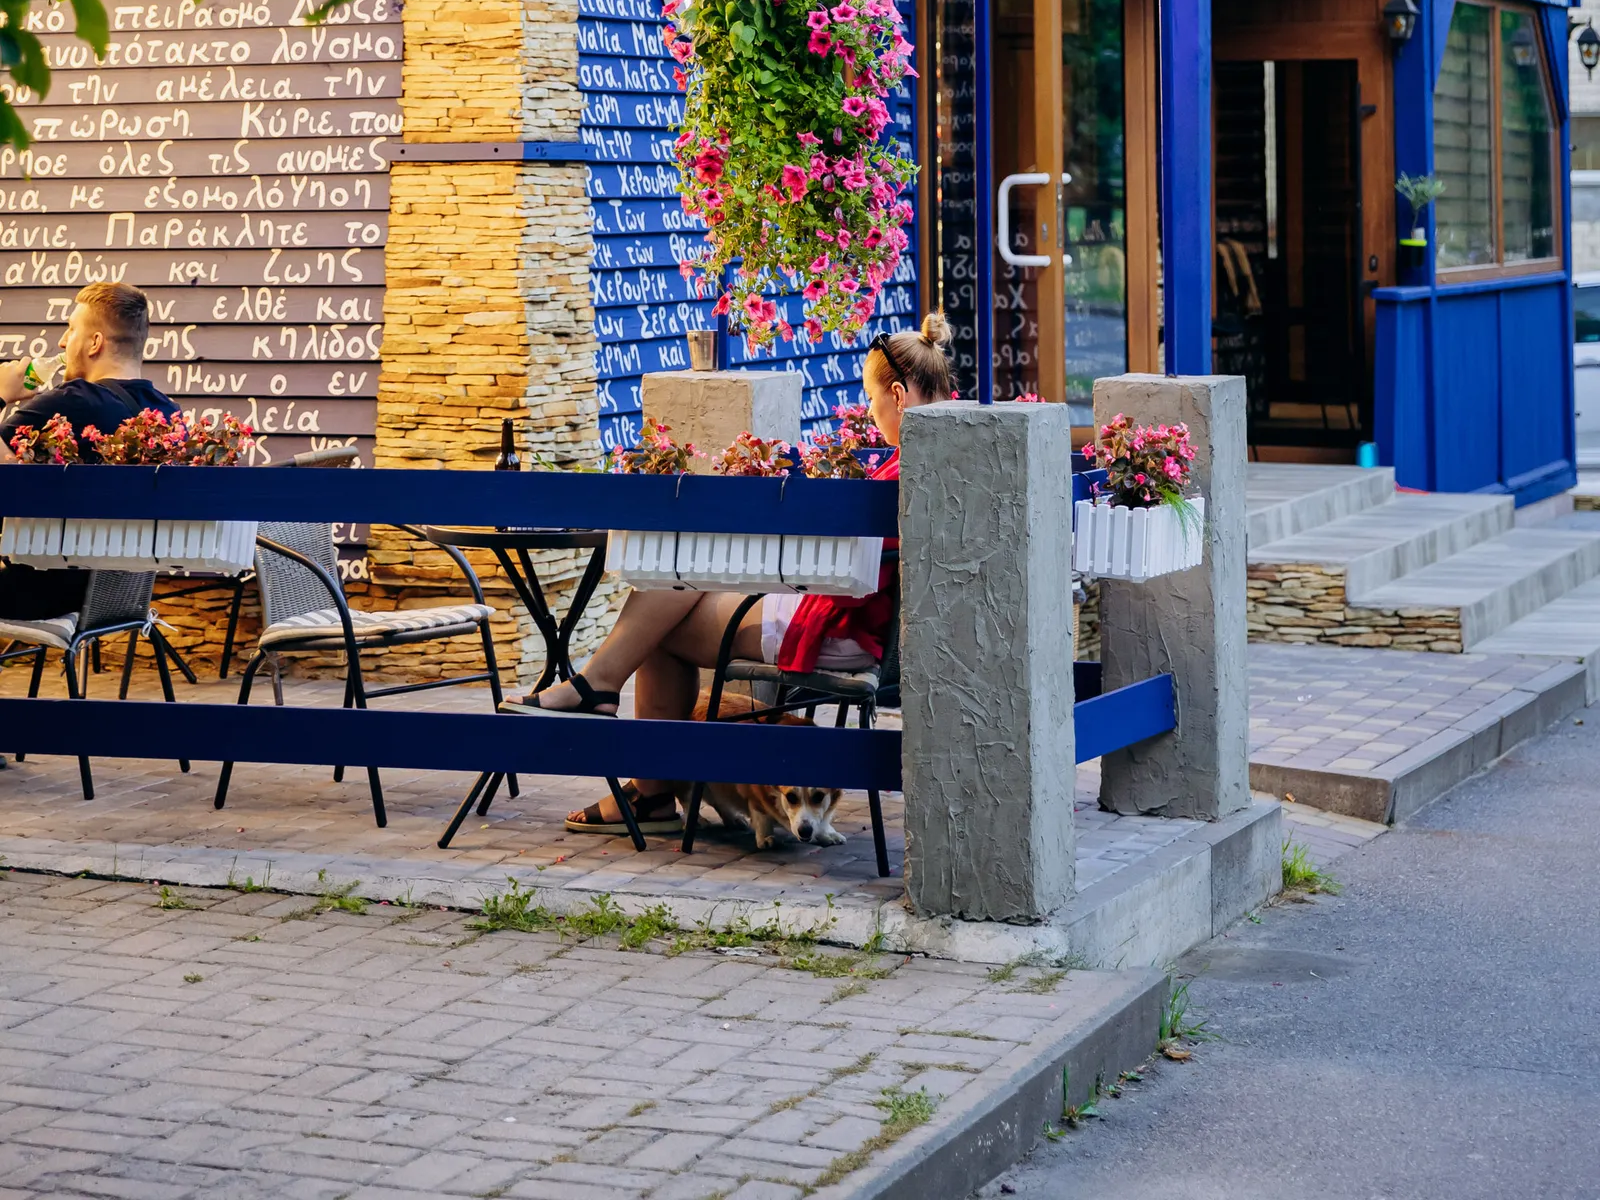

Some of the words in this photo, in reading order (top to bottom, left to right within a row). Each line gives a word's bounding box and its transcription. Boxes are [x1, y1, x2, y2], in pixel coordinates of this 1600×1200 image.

[68, 75, 119, 104] την
[324, 67, 386, 97] την
[99, 140, 174, 176] όλες
[70, 185, 104, 209] με
[105, 212, 308, 248] Παράκλητε
[344, 220, 381, 243] το
[169, 261, 219, 284] και
[212, 287, 288, 322] ελθέ
[316, 296, 373, 321] και
[252, 324, 383, 361] κηλίδος
[327, 370, 368, 394] εν
